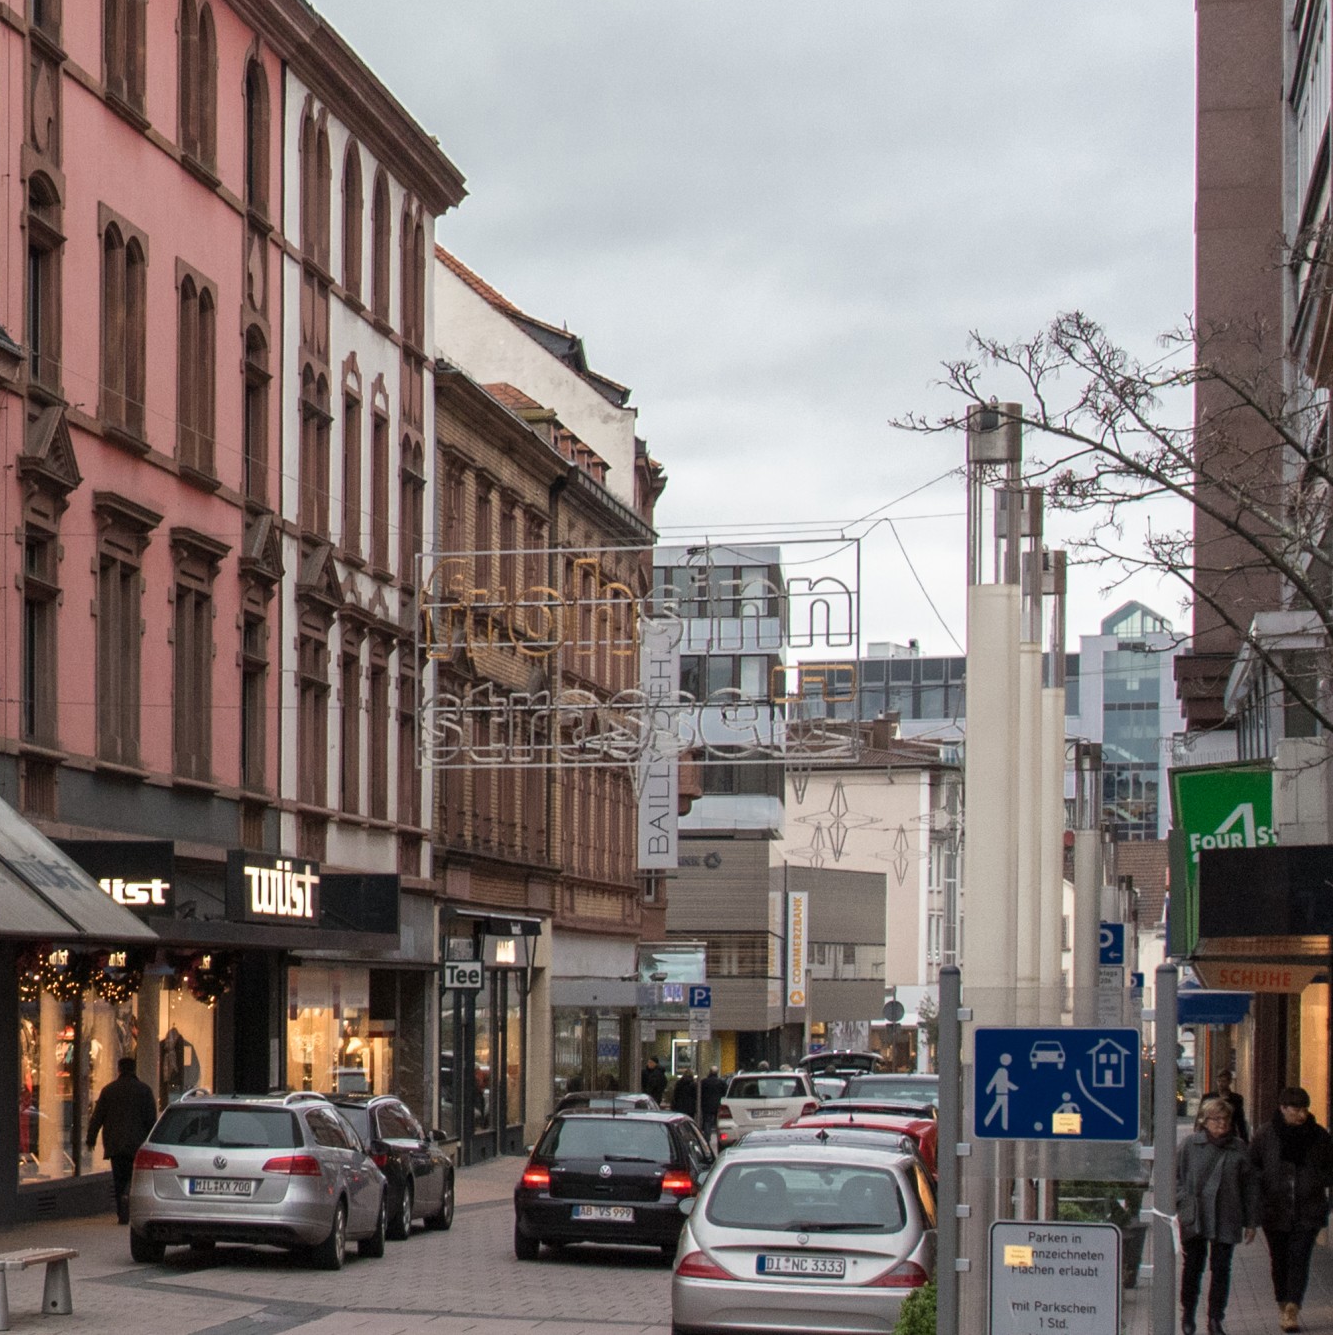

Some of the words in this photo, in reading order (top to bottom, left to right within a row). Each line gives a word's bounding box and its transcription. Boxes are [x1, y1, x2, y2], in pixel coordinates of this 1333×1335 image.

[1190, 832, 1243, 852] FOUR
[244, 860, 320, 917] wüst
[793, 896, 802, 984] COMMERZBANK
[446, 965, 480, 985] Tee
[1219, 969, 1292, 987] SCHUHE
[694, 989, 707, 1006] P
[220, 1182, 231, 1192] KX
[580, 1207, 593, 1216] AB
[599, 1207, 611, 1217] VS
[613, 1208, 631, 1217] 999
[1028, 1231, 1067, 1244] Parken
[1072, 1233, 1082, 1244] in
[1032, 1249, 1104, 1261] nnzeichneten
[766, 1258, 781, 1270] DI
[792, 1259, 807, 1271] NC
[811, 1260, 843, 1273] 3333
[1058, 1266, 1098, 1277] erlaubt
[1012, 1301, 1030, 1311] mit
[1034, 1301, 1097, 1315] Parkschein
[1047, 1317, 1069, 1329] Std.
